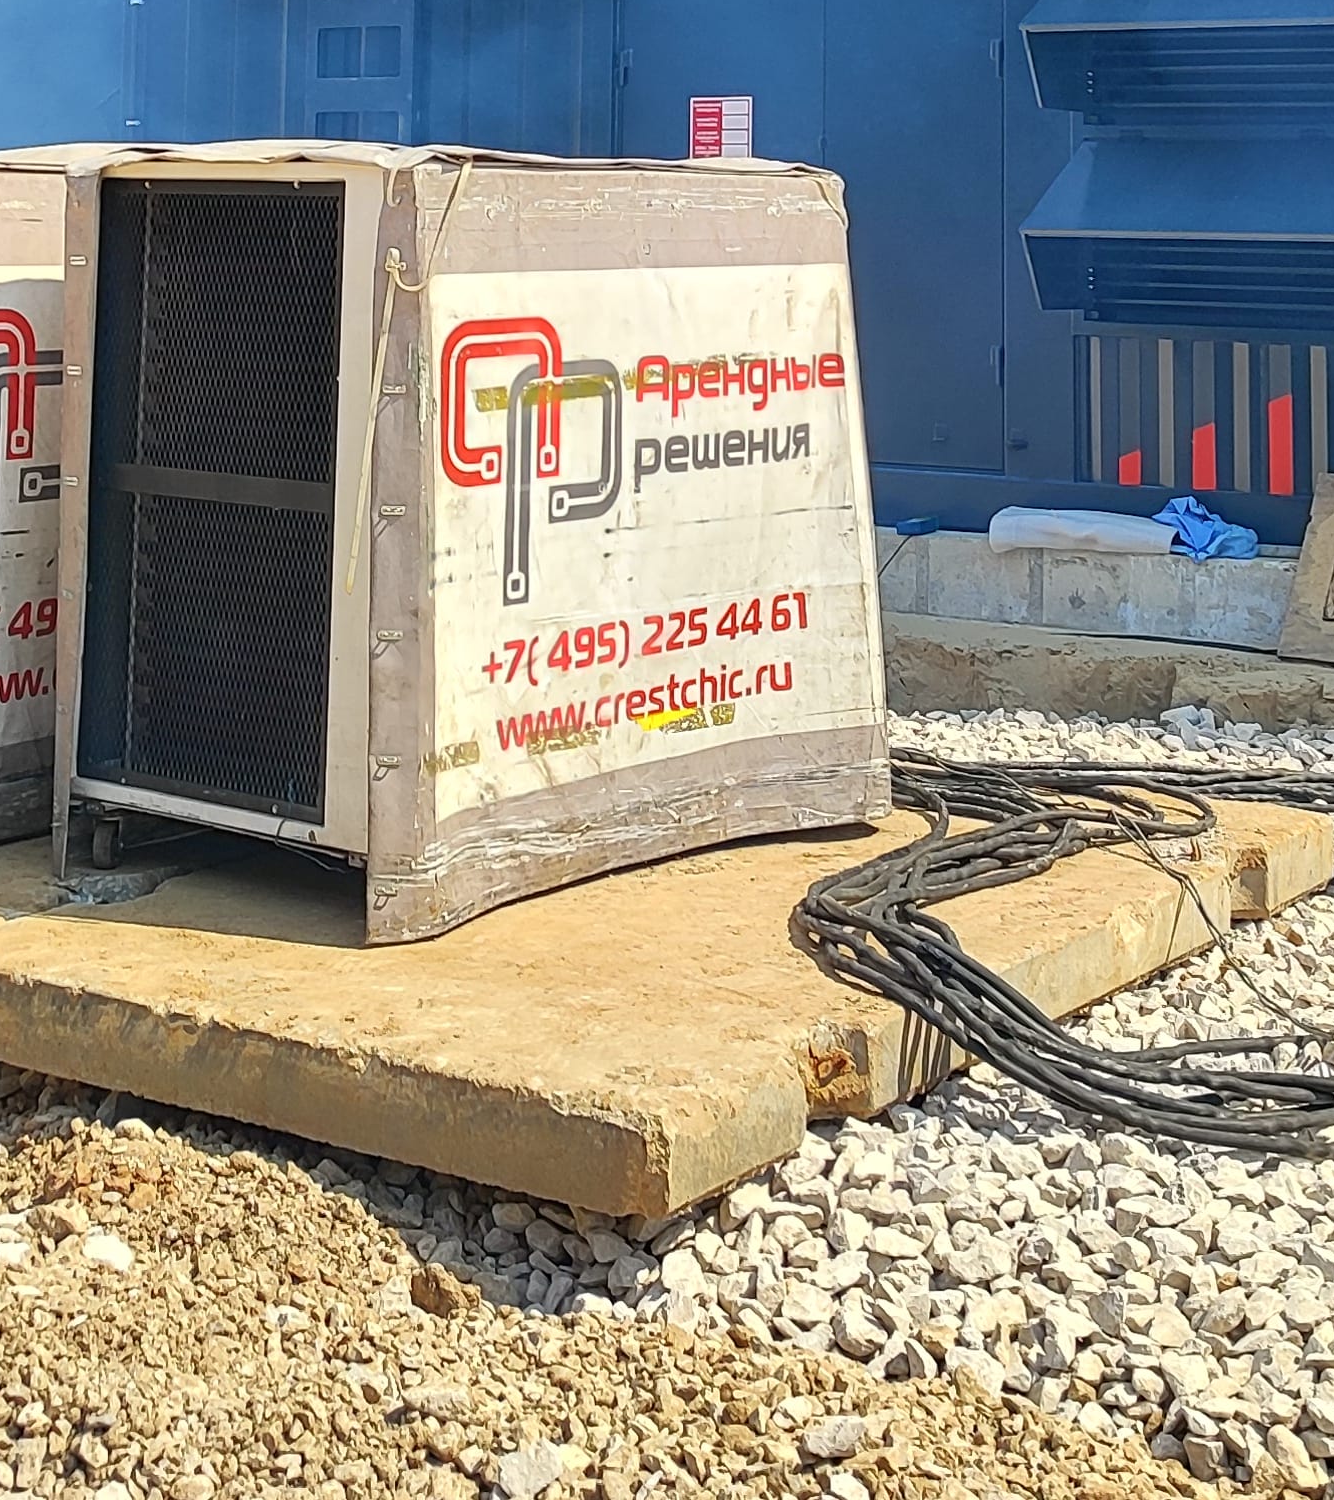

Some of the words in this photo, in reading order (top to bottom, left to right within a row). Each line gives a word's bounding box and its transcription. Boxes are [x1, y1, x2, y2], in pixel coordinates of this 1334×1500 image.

[636, 353, 845, 418] Арендные
[634, 423, 810, 493] решения
[8, 598, 58, 639] 49
[641, 607, 707, 656] 225
[717, 598, 762, 640] 44
[771, 592, 807, 631] 61
[496, 661, 793, 750] www.crestchic.ru
